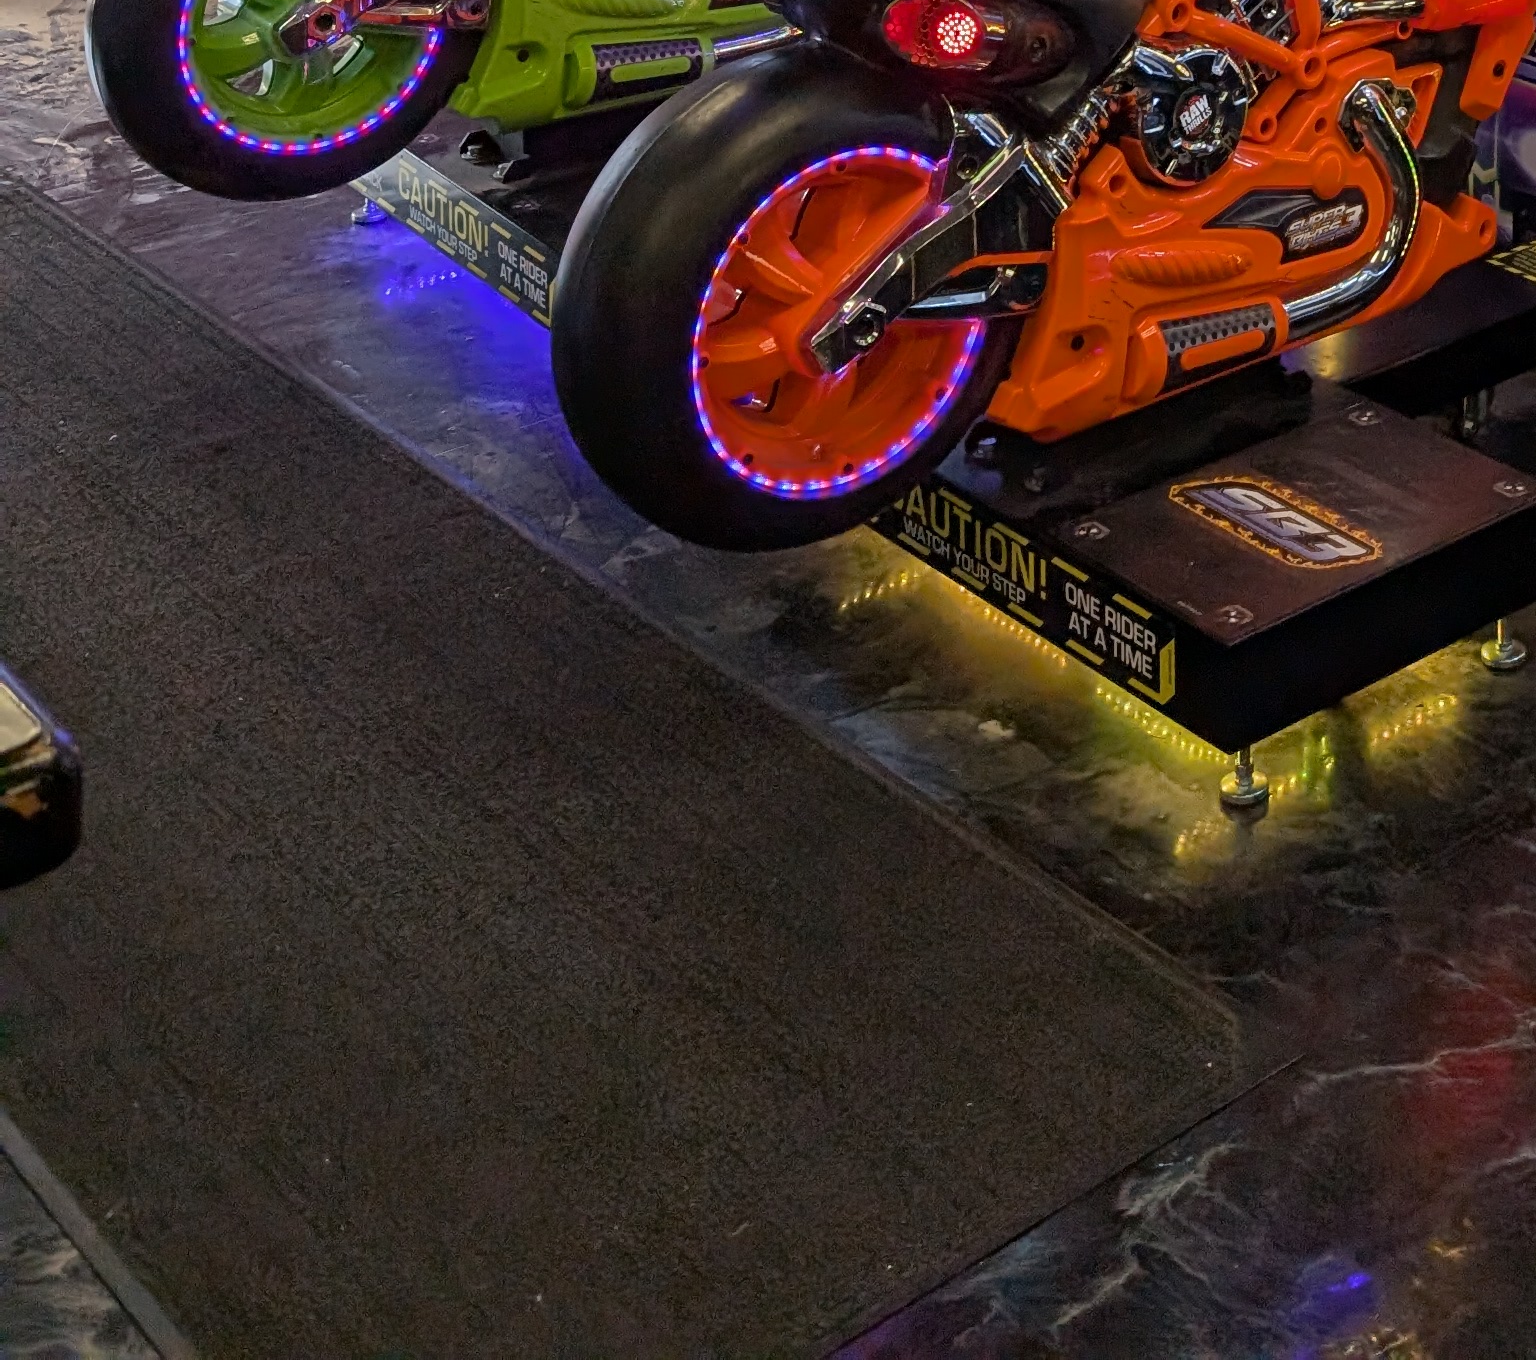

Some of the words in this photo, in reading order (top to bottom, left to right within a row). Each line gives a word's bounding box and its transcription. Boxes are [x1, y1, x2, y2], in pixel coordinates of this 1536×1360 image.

[1179, 94, 1209, 128] RAW
[1184, 106, 1213, 135] THRILLS
[398, 167, 489, 258] CAUTION!
[409, 204, 437, 233] WATCH
[436, 224, 458, 251] YOUR
[458, 243, 478, 262] STEP
[497, 240, 518, 268] ONE
[519, 254, 548, 289] RIDER
[499, 262, 513, 284] AT
[513, 274, 522, 292] A
[522, 279, 547, 310] TIME
[896, 484, 1048, 601] AUTION!
[903, 516, 951, 559] WATCH
[953, 546, 990, 585] YOUR
[992, 573, 1027, 604] STEP
[1064, 581, 1101, 619] ONE
[1104, 605, 1157, 655] RIDER
[1068, 611, 1092, 640] AT
[1094, 628, 1108, 651] A
[1110, 631, 1154, 680] TIME
